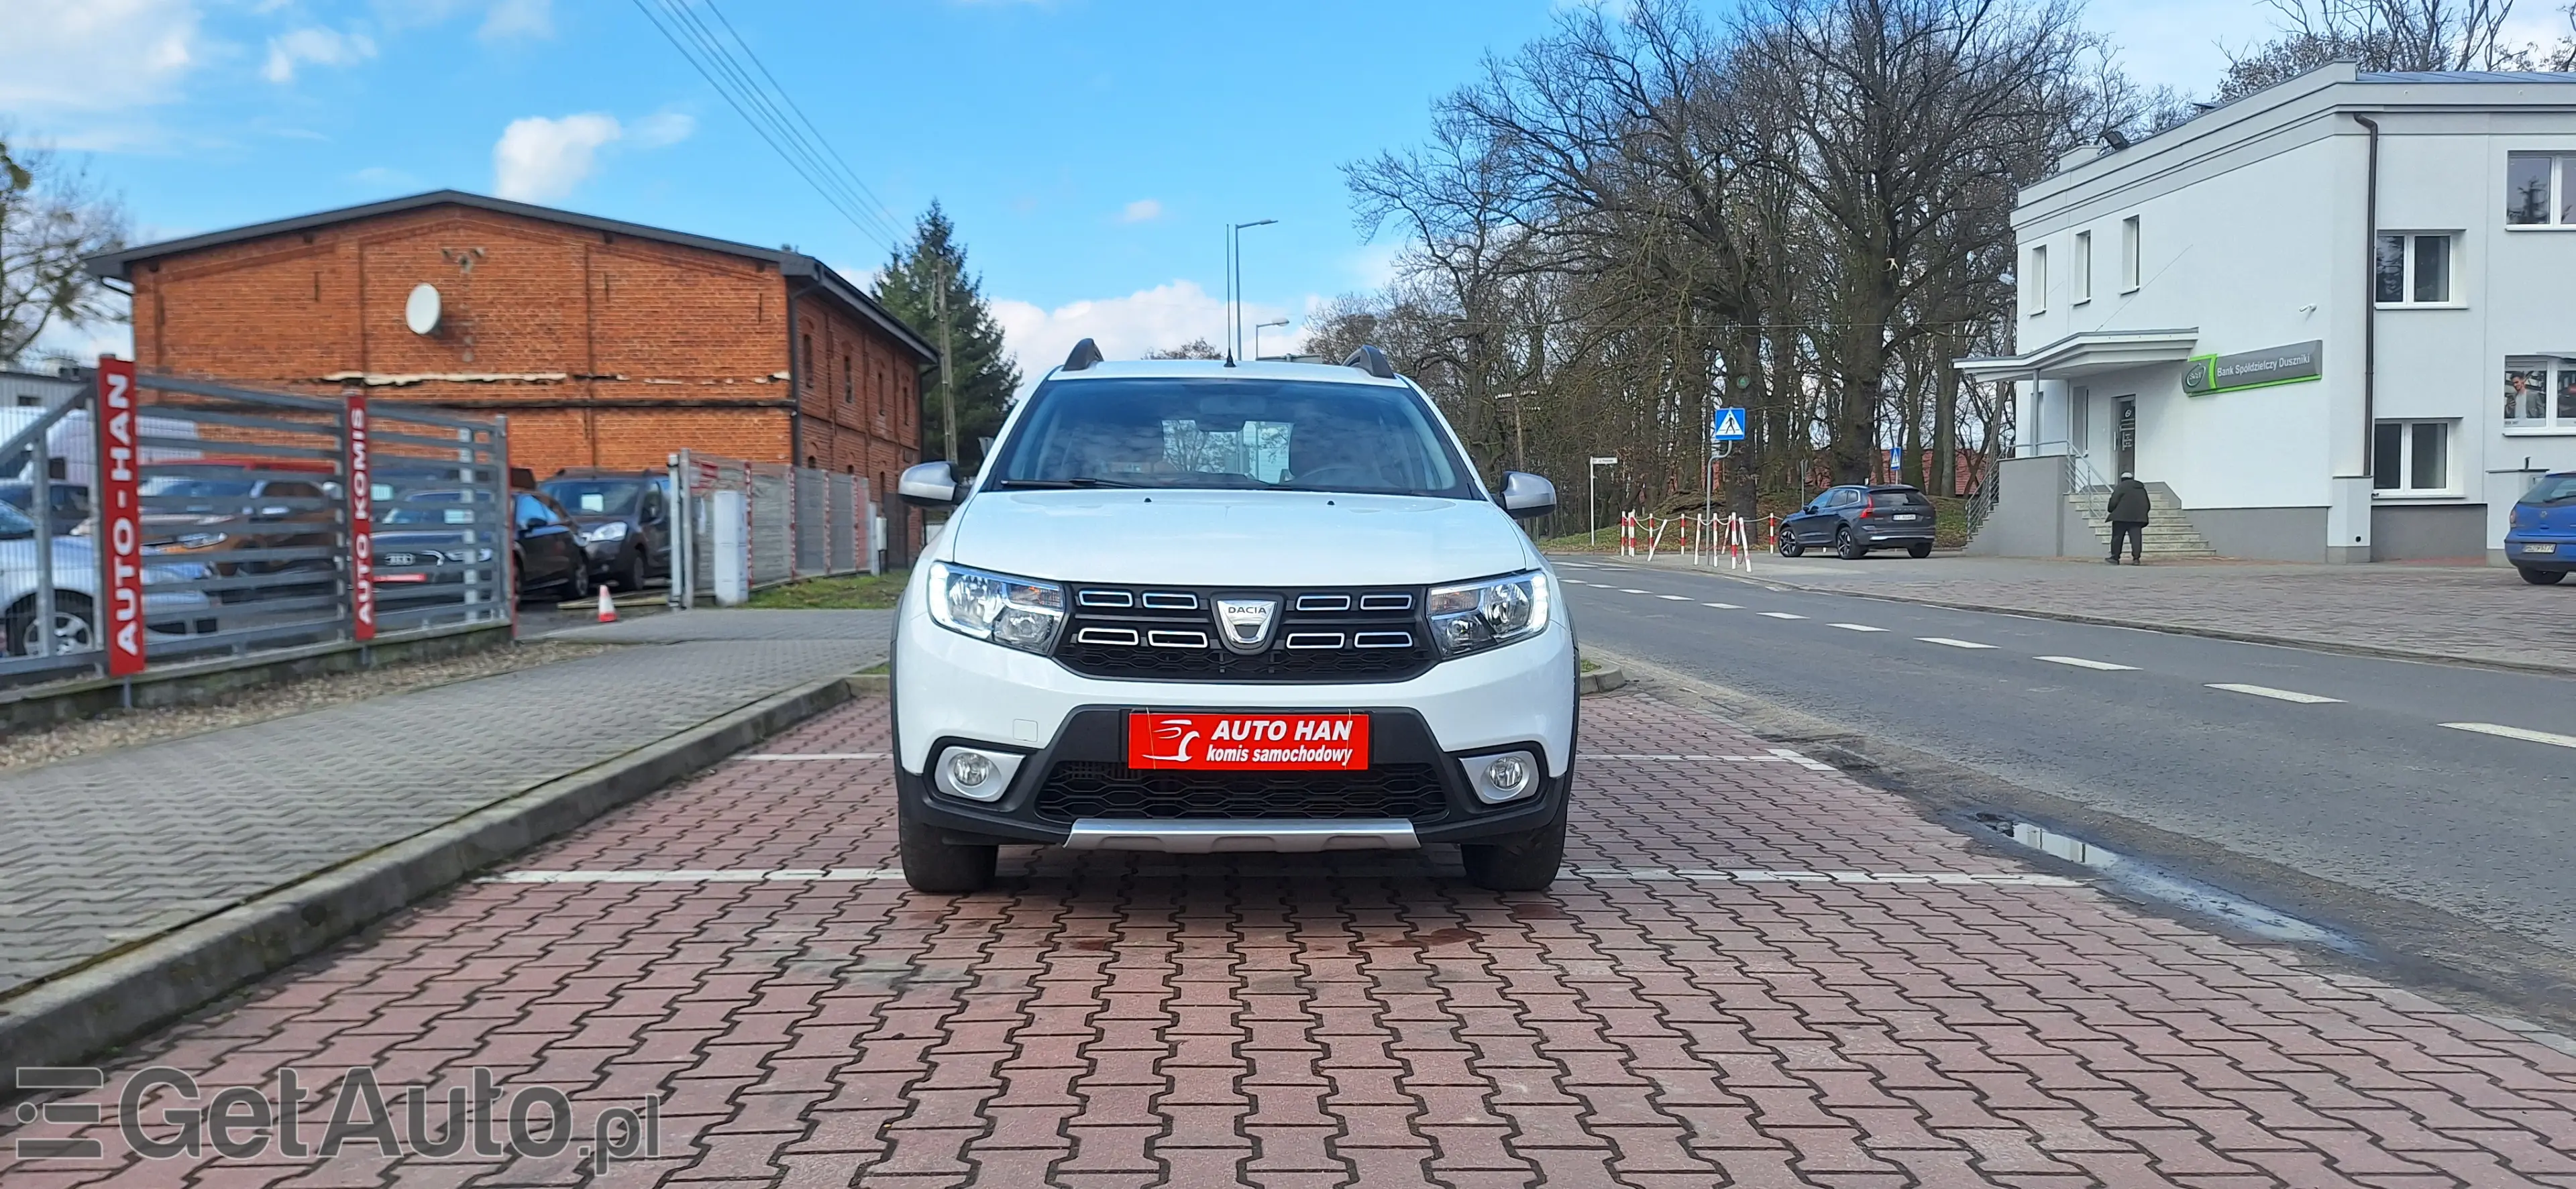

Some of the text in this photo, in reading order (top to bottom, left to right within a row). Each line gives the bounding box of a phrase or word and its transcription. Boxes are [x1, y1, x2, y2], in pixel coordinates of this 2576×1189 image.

[2216, 366, 2234, 377] Bank
[2235, 360, 2277, 376] Spółdzielczy
[2279, 353, 2310, 368] Duszniki
[351, 408, 372, 625] AUTO KOMIS
[113, 517, 138, 656] AUTO
[1228, 606, 1267, 614] DACIA
[1210, 720, 1353, 741] AUTO HAN
[1206, 744, 1353, 766] komis samochodowy
